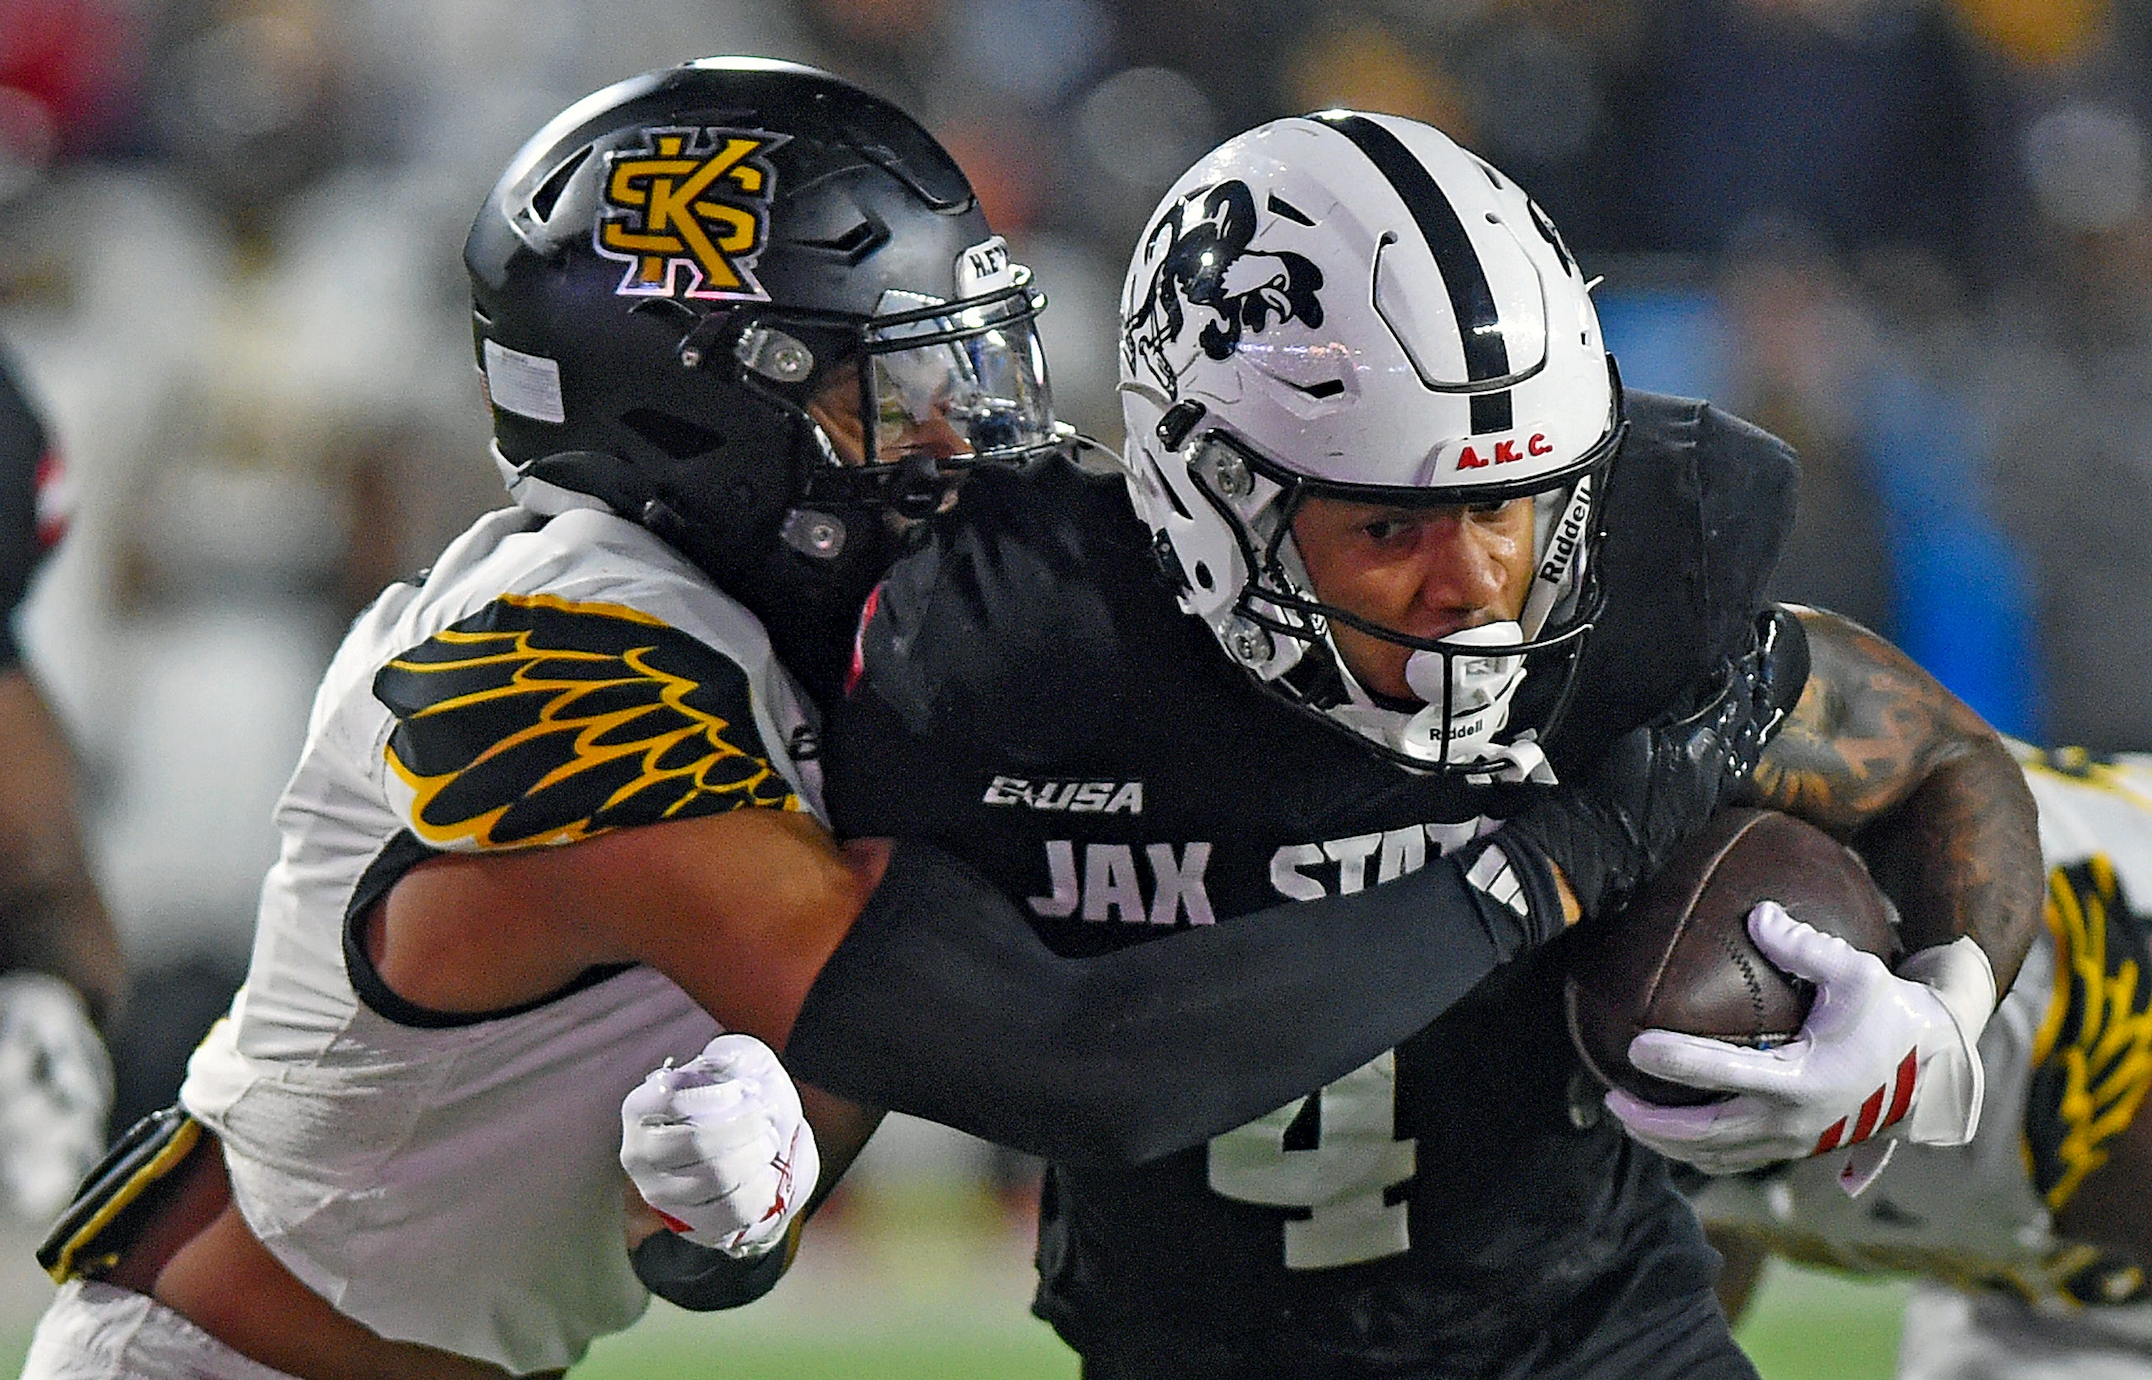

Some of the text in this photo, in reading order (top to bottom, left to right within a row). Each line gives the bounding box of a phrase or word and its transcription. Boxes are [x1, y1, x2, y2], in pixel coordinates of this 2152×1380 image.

[1538, 486, 1592, 585] Riddell
[1428, 718, 1484, 742] Rddell
[1025, 813, 1507, 926] JAX STAT
[1207, 1045, 1418, 1271] 4
